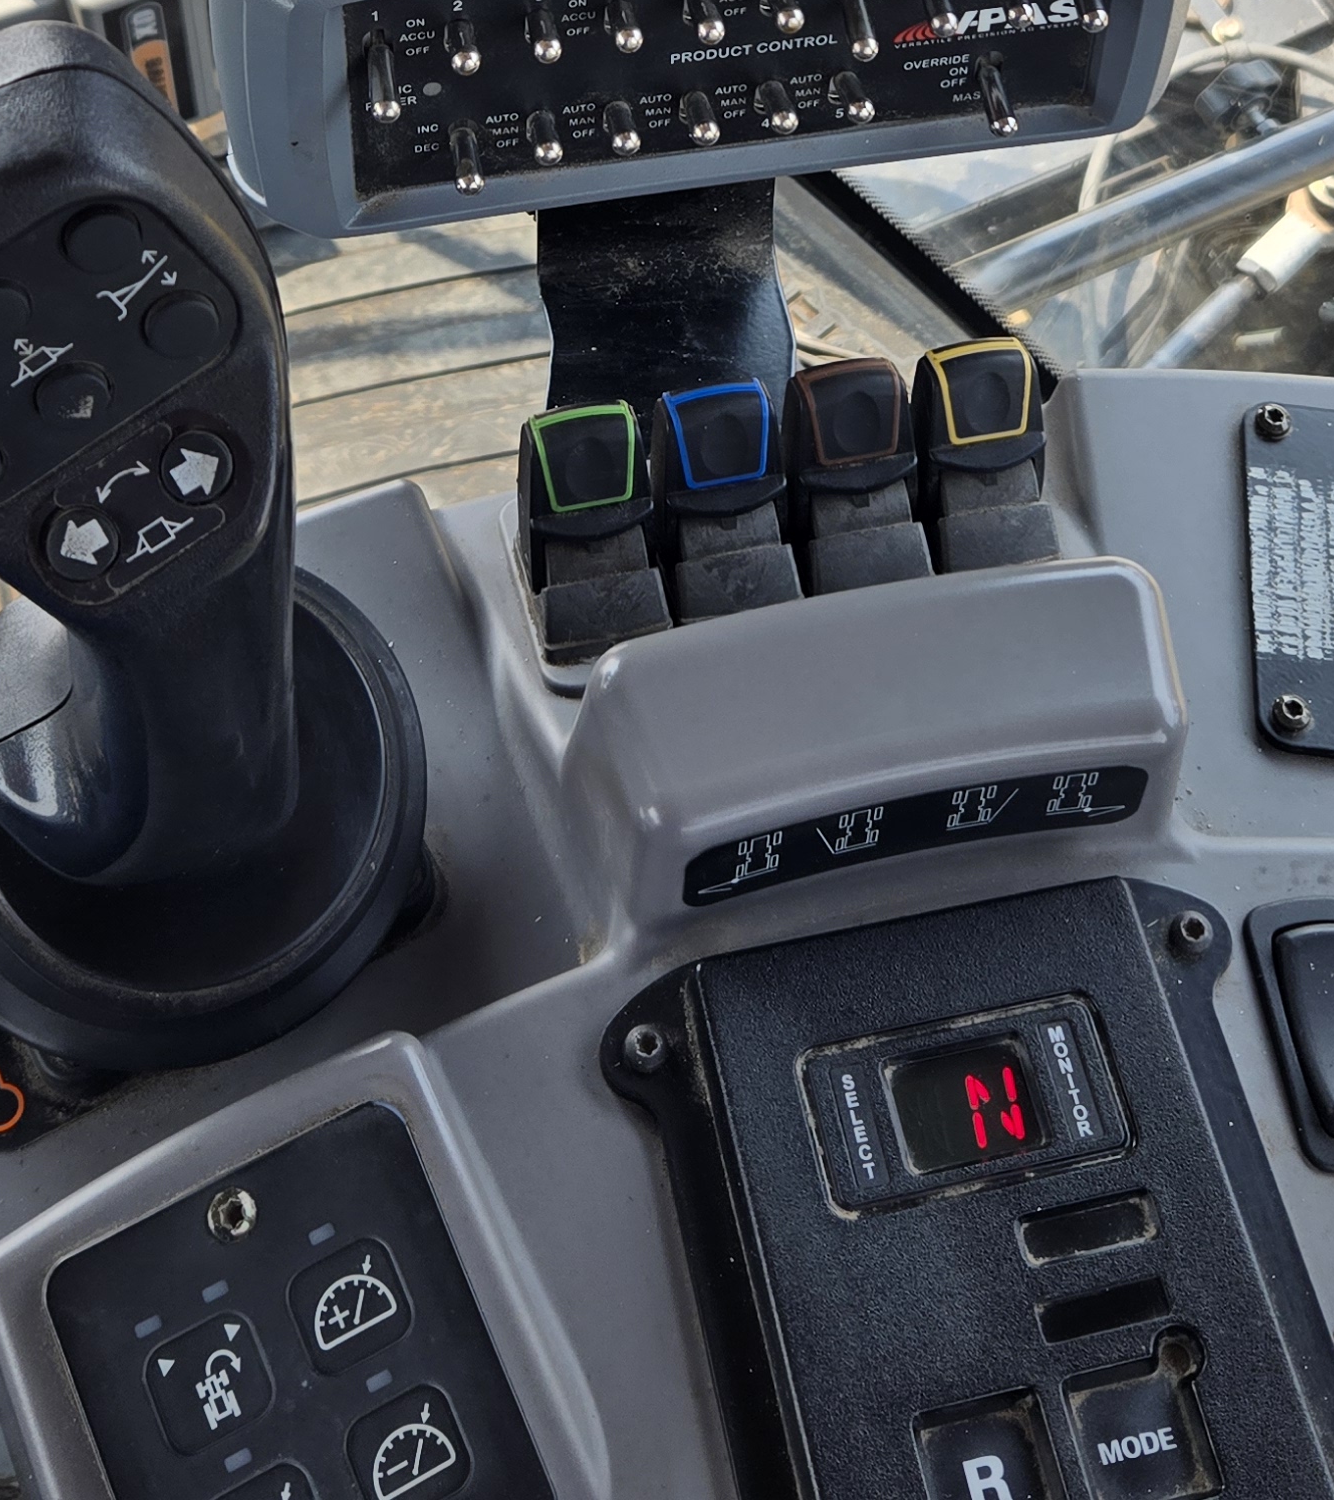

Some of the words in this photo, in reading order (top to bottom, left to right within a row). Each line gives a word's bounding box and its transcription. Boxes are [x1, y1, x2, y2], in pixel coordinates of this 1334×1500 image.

[453, 1, 463, 11] 2
[723, 6, 747, 17] OFF
[372, 12, 379, 22] 1
[561, 11, 596, 22] ACCU
[406, 18, 425, 28] ON
[399, 30, 436, 42] ACCU
[566, 26, 591, 36] OFF
[405, 46, 430, 56] OFF
[670, 44, 750, 65] PRODUCT
[756, 33, 838, 54] CONTROL
[903, 54, 970, 71] OVERRIDE
[948, 65, 968, 76] ON
[789, 73, 822, 84] AUTO
[940, 77, 967, 89] OFF
[715, 84, 748, 95] AUTO
[795, 86, 821, 97] MAN
[639, 93, 672, 105] AUTO
[720, 97, 747, 107] MAN
[798, 99, 820, 110] OFF
[562, 103, 596, 114] AUTO
[645, 106, 671, 117] MAN
[835, 108, 844, 119] 5
[485, 113, 519, 124] AUTO
[723, 109, 747, 120] OFF
[569, 116, 595, 126] MAN
[649, 119, 671, 130] OFF
[417, 124, 439, 134] INC
[492, 125, 520, 136] MAN
[572, 129, 595, 139] OFF
[414, 142, 439, 153] DEC
[496, 138, 519, 149] OFF
[1048, 1025, 1093, 1137] MONITOR
[841, 1074, 874, 1181] SELECT
[1097, 1428, 1178, 1466] MODE
[962, 1455, 1013, 1500] R
